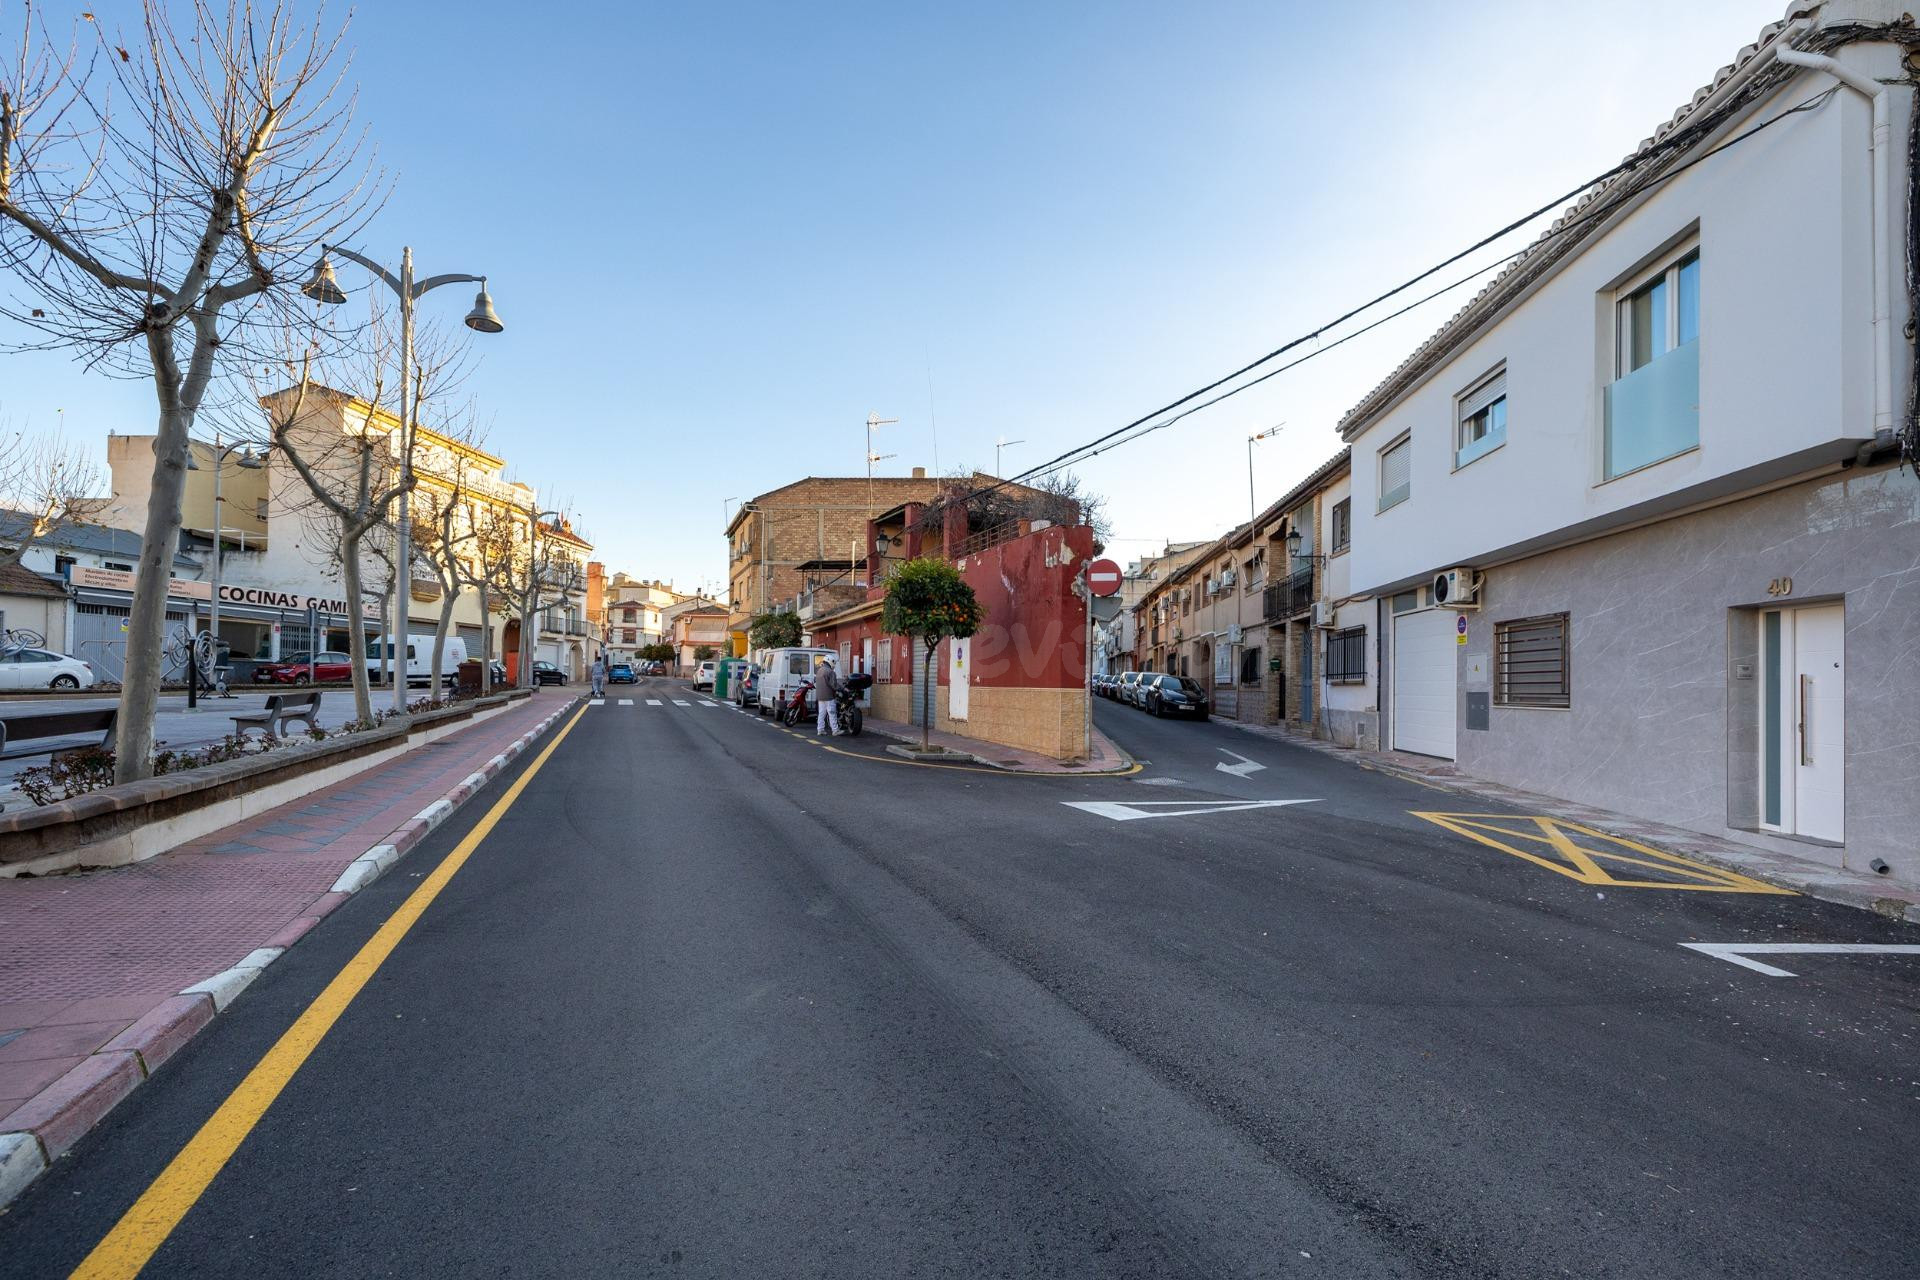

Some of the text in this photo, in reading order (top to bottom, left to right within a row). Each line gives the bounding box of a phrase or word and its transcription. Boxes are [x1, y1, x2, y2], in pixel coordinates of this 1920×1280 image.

[1767, 577, 1793, 597] 40
[218, 586, 298, 608] COCINAS
[306, 597, 348, 614] GAMI
